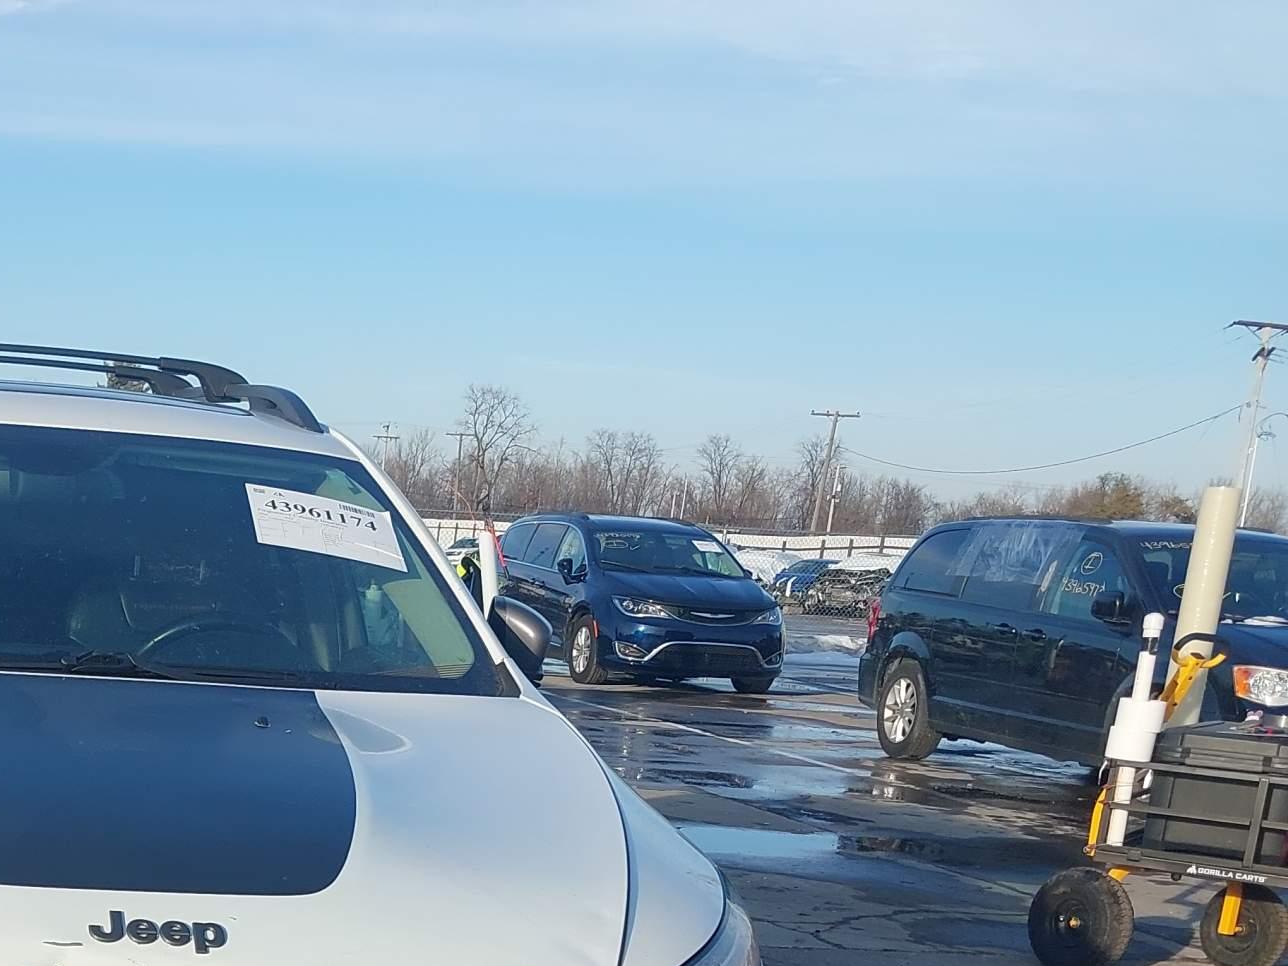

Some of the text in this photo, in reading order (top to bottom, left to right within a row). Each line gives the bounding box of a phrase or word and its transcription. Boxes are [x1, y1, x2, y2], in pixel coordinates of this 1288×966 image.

[264, 499, 378, 532] 43961174
[1139, 541, 1193, 550] 43965
[1197, 867, 1266, 883] GORILLA CARTS
[88, 910, 228, 954] Jeep
